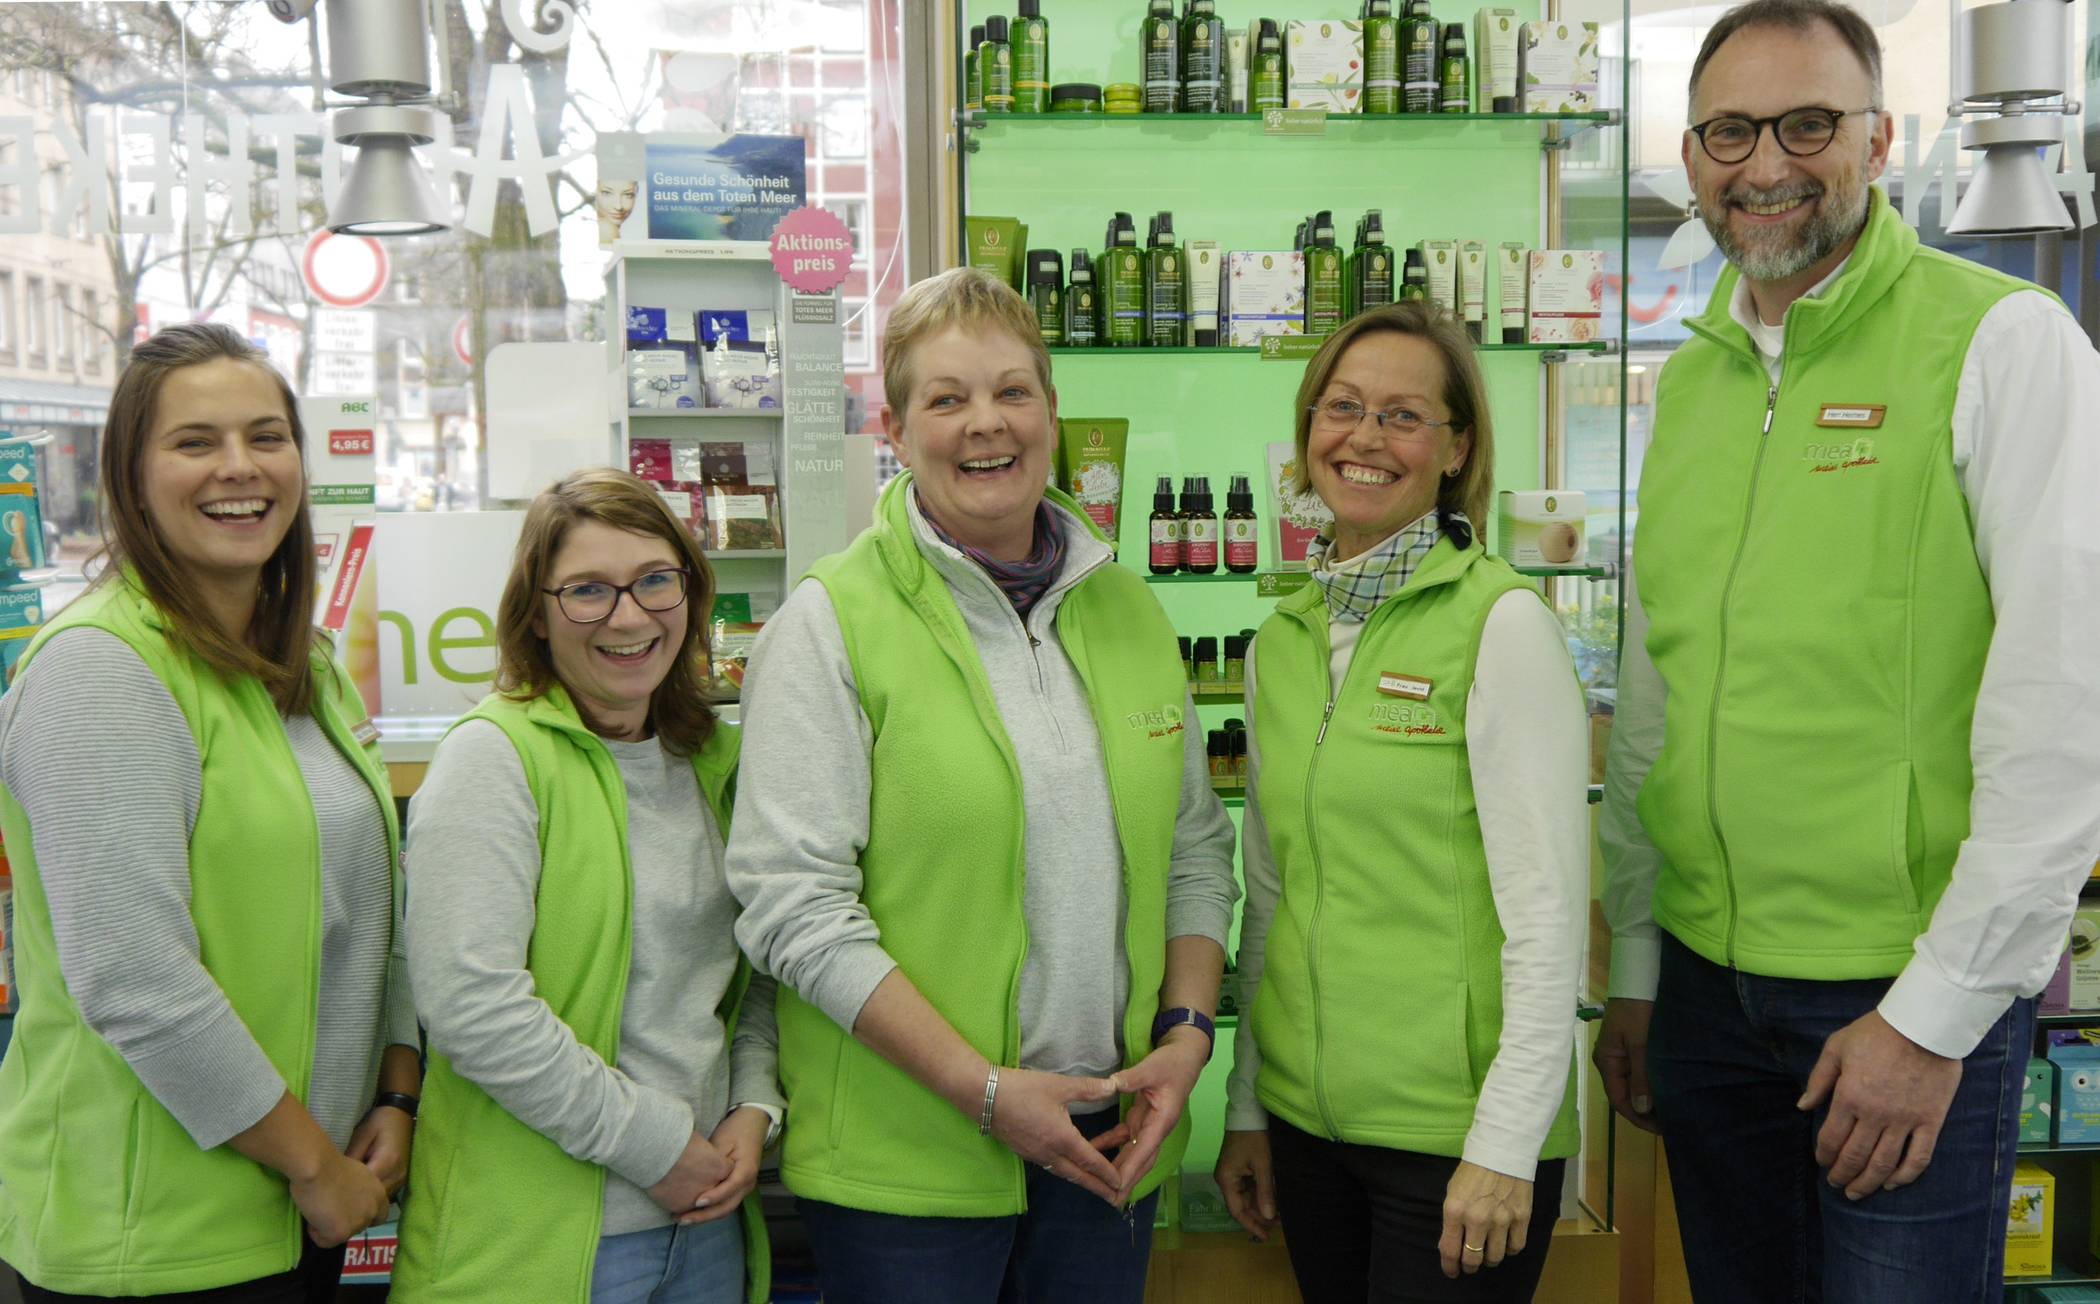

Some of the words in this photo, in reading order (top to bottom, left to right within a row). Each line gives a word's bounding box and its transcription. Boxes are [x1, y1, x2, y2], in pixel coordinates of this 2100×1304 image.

[653, 172, 715, 187] Gesunde
[720, 173, 790, 188] Schönheit
[654, 191, 678, 202] aus
[683, 189, 714, 203] dem
[718, 190, 756, 204] Toten
[761, 190, 797, 204] Meer
[777, 233, 850, 252] Aktions-
[794, 254, 836, 274] preis
[795, 362, 843, 372] BALANCE
[341, 402, 368, 413] ABC
[786, 399, 835, 414] GLÄTTE
[792, 414, 840, 424] SCHÖNHEIT
[332, 440, 360, 451] 4,95
[1803, 443, 1852, 461] mea
[794, 459, 844, 472] NATUR
[328, 488, 344, 496] ZUR
[346, 487, 370, 496] HAUT
[1368, 703, 1412, 723] mea
